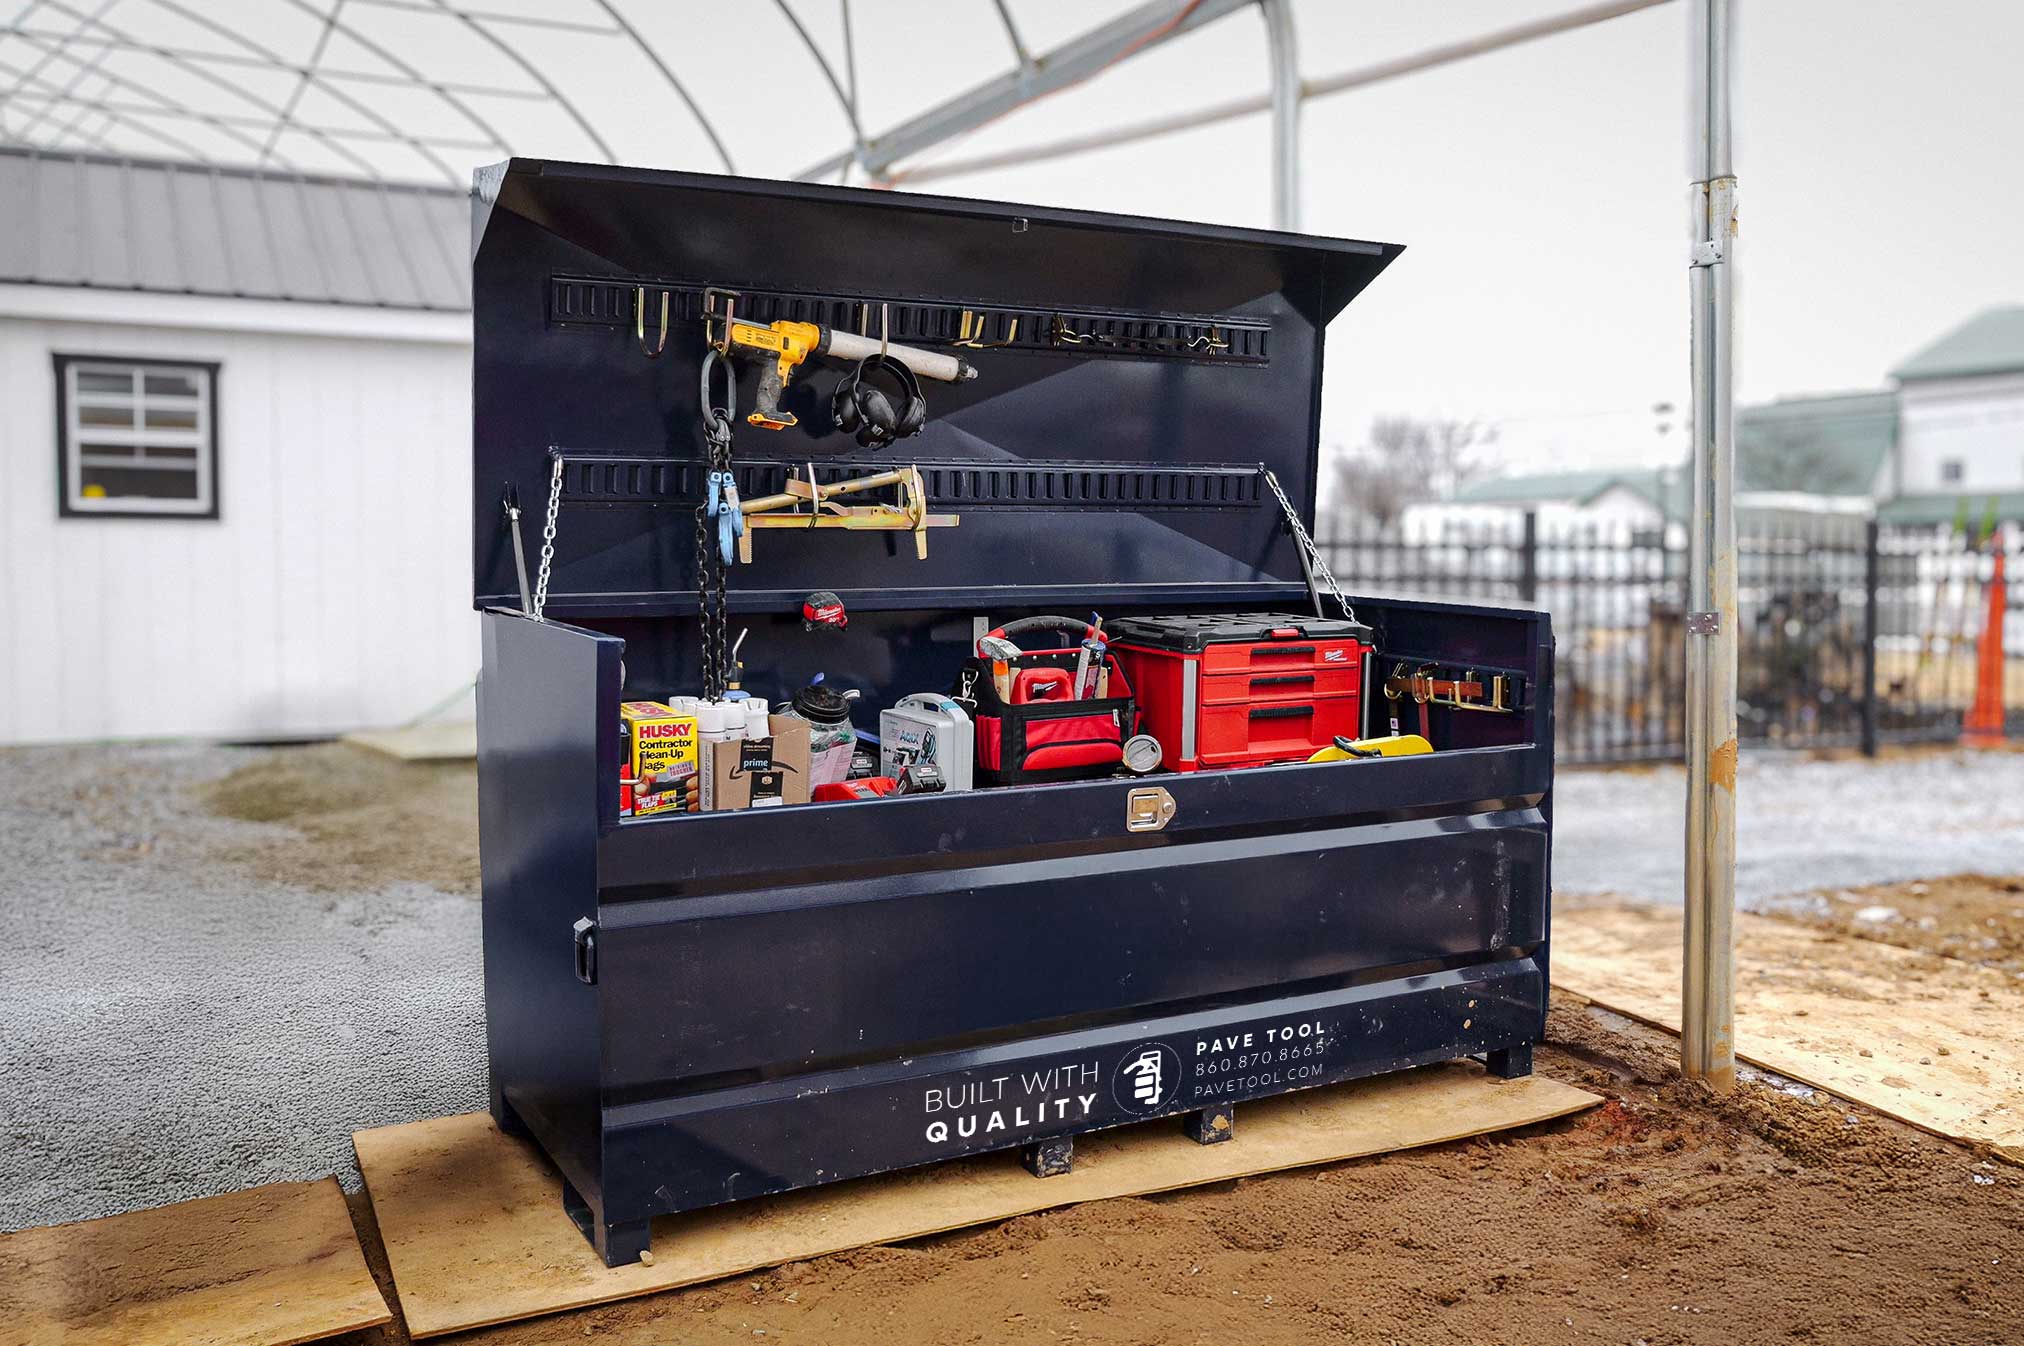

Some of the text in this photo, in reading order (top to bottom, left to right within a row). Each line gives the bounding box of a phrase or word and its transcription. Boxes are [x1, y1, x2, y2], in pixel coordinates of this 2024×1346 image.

[639, 723, 692, 738] HUSKY
[639, 739, 692, 750] Contractor
[642, 761, 666, 771] ags
[743, 758, 769, 768] prime
[1196, 1021, 1325, 1056] PAVE TOOL
[1195, 1041, 1324, 1077] 860.870.8665
[925, 1061, 1099, 1113] BUILT WITH
[1194, 1063, 1323, 1099] PAVETOOL.COM
[925, 1093, 1097, 1143] QUALITY
